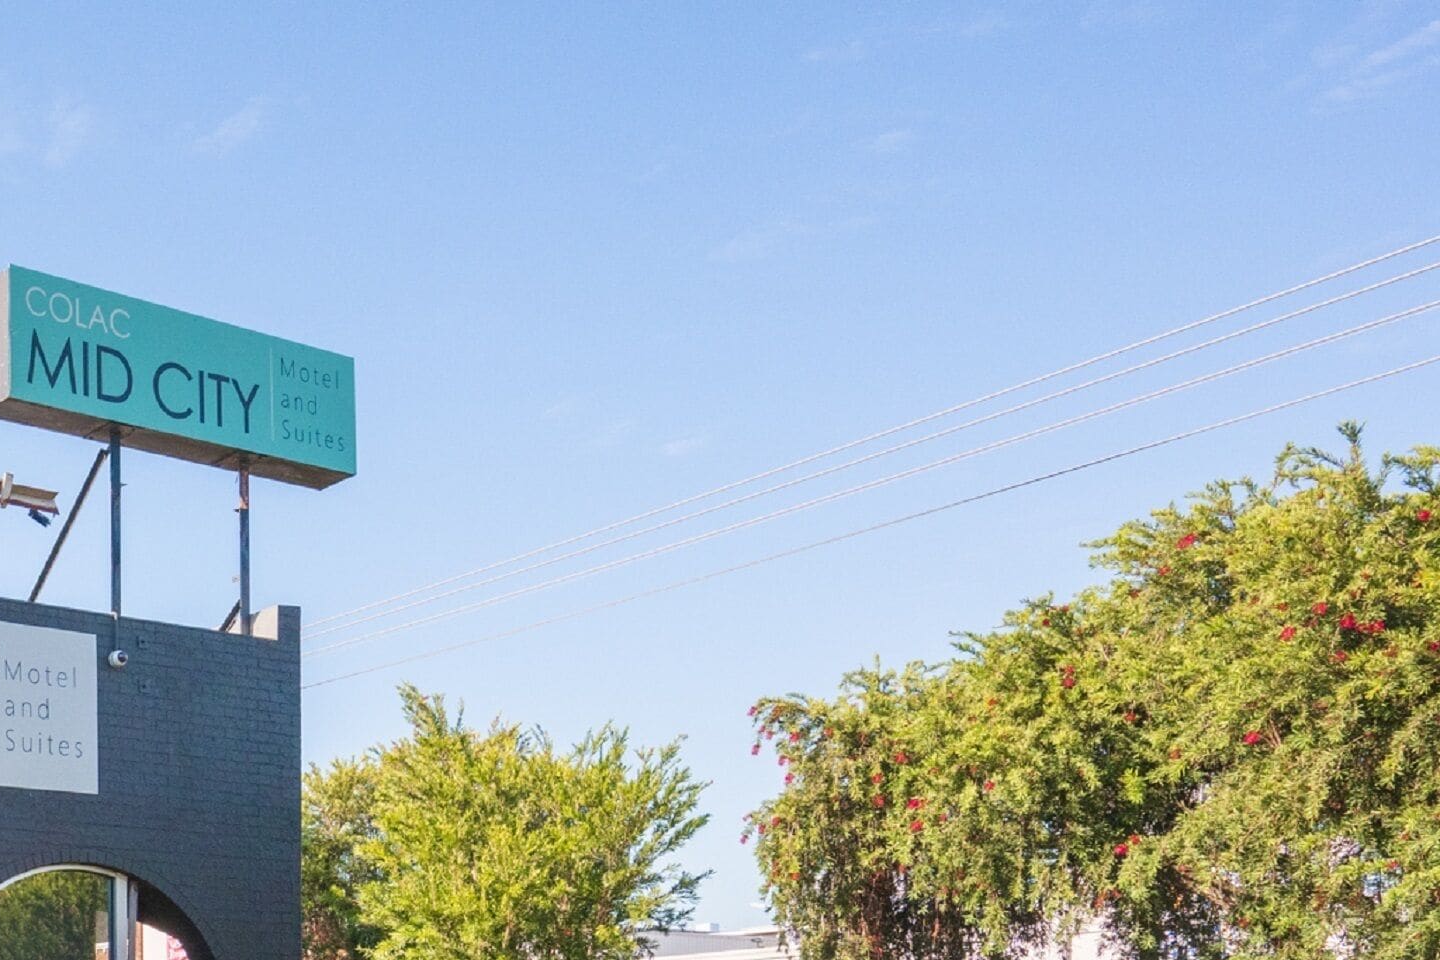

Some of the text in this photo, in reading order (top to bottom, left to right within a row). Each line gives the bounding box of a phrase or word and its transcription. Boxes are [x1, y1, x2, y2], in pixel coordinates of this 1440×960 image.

[25, 286, 131, 339] COLAC
[26, 327, 260, 433] MID CITY
[279, 357, 340, 388] Motel
[280, 393, 318, 415] and
[281, 419, 346, 453] Suites
[4, 659, 77, 688] Motel
[4, 697, 51, 721] and
[5, 728, 84, 759] Suites
